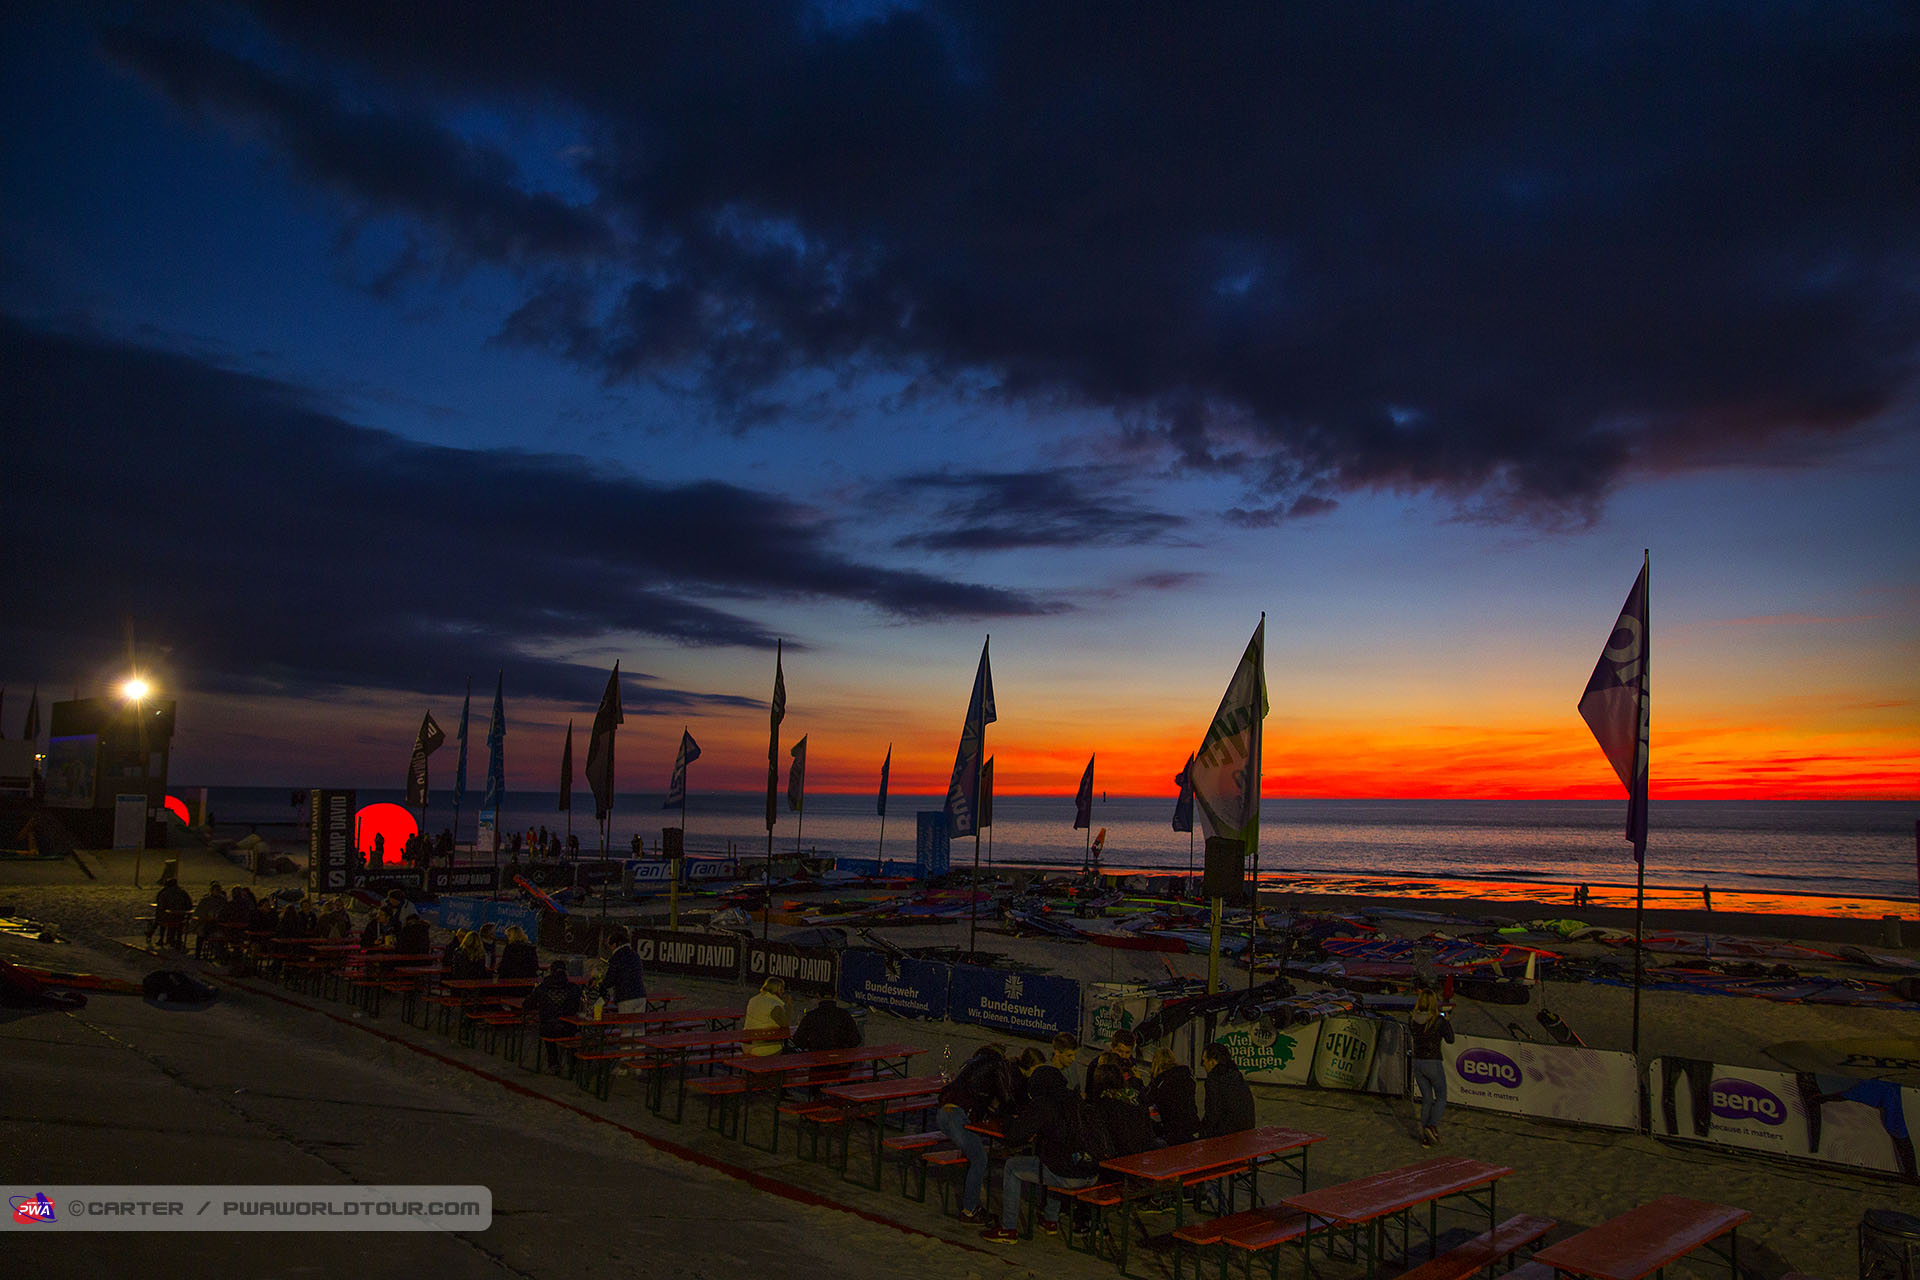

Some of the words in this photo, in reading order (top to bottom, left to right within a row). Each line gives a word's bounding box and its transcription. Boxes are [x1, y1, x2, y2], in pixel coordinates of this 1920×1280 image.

[329, 795, 347, 830] DAVID
[329, 832, 347, 867] CAMP
[634, 865, 660, 877] ran
[658, 941, 695, 965] CAMP
[697, 944, 735, 968] DAVID
[768, 953, 799, 977] CAMP
[800, 957, 832, 982] DAVID
[865, 979, 920, 999] Bundeswehr
[980, 996, 1047, 1018] Bundeswehr
[982, 1010, 1010, 1023] Dienen.
[1010, 1014, 1059, 1032] Deutschland.
[1228, 1034, 1252, 1046] Viel
[1257, 1045, 1274, 1056] da
[1326, 1032, 1367, 1061] JEVER
[1463, 1059, 1517, 1083] BenQ
[1460, 1086, 1486, 1097] Because
[1487, 1090, 1493, 1098] it
[1493, 1092, 1519, 1102] matters
[1712, 1092, 1780, 1119] BenQ
[1743, 1127, 1749, 1135] it
[1751, 1129, 1784, 1141] matters
